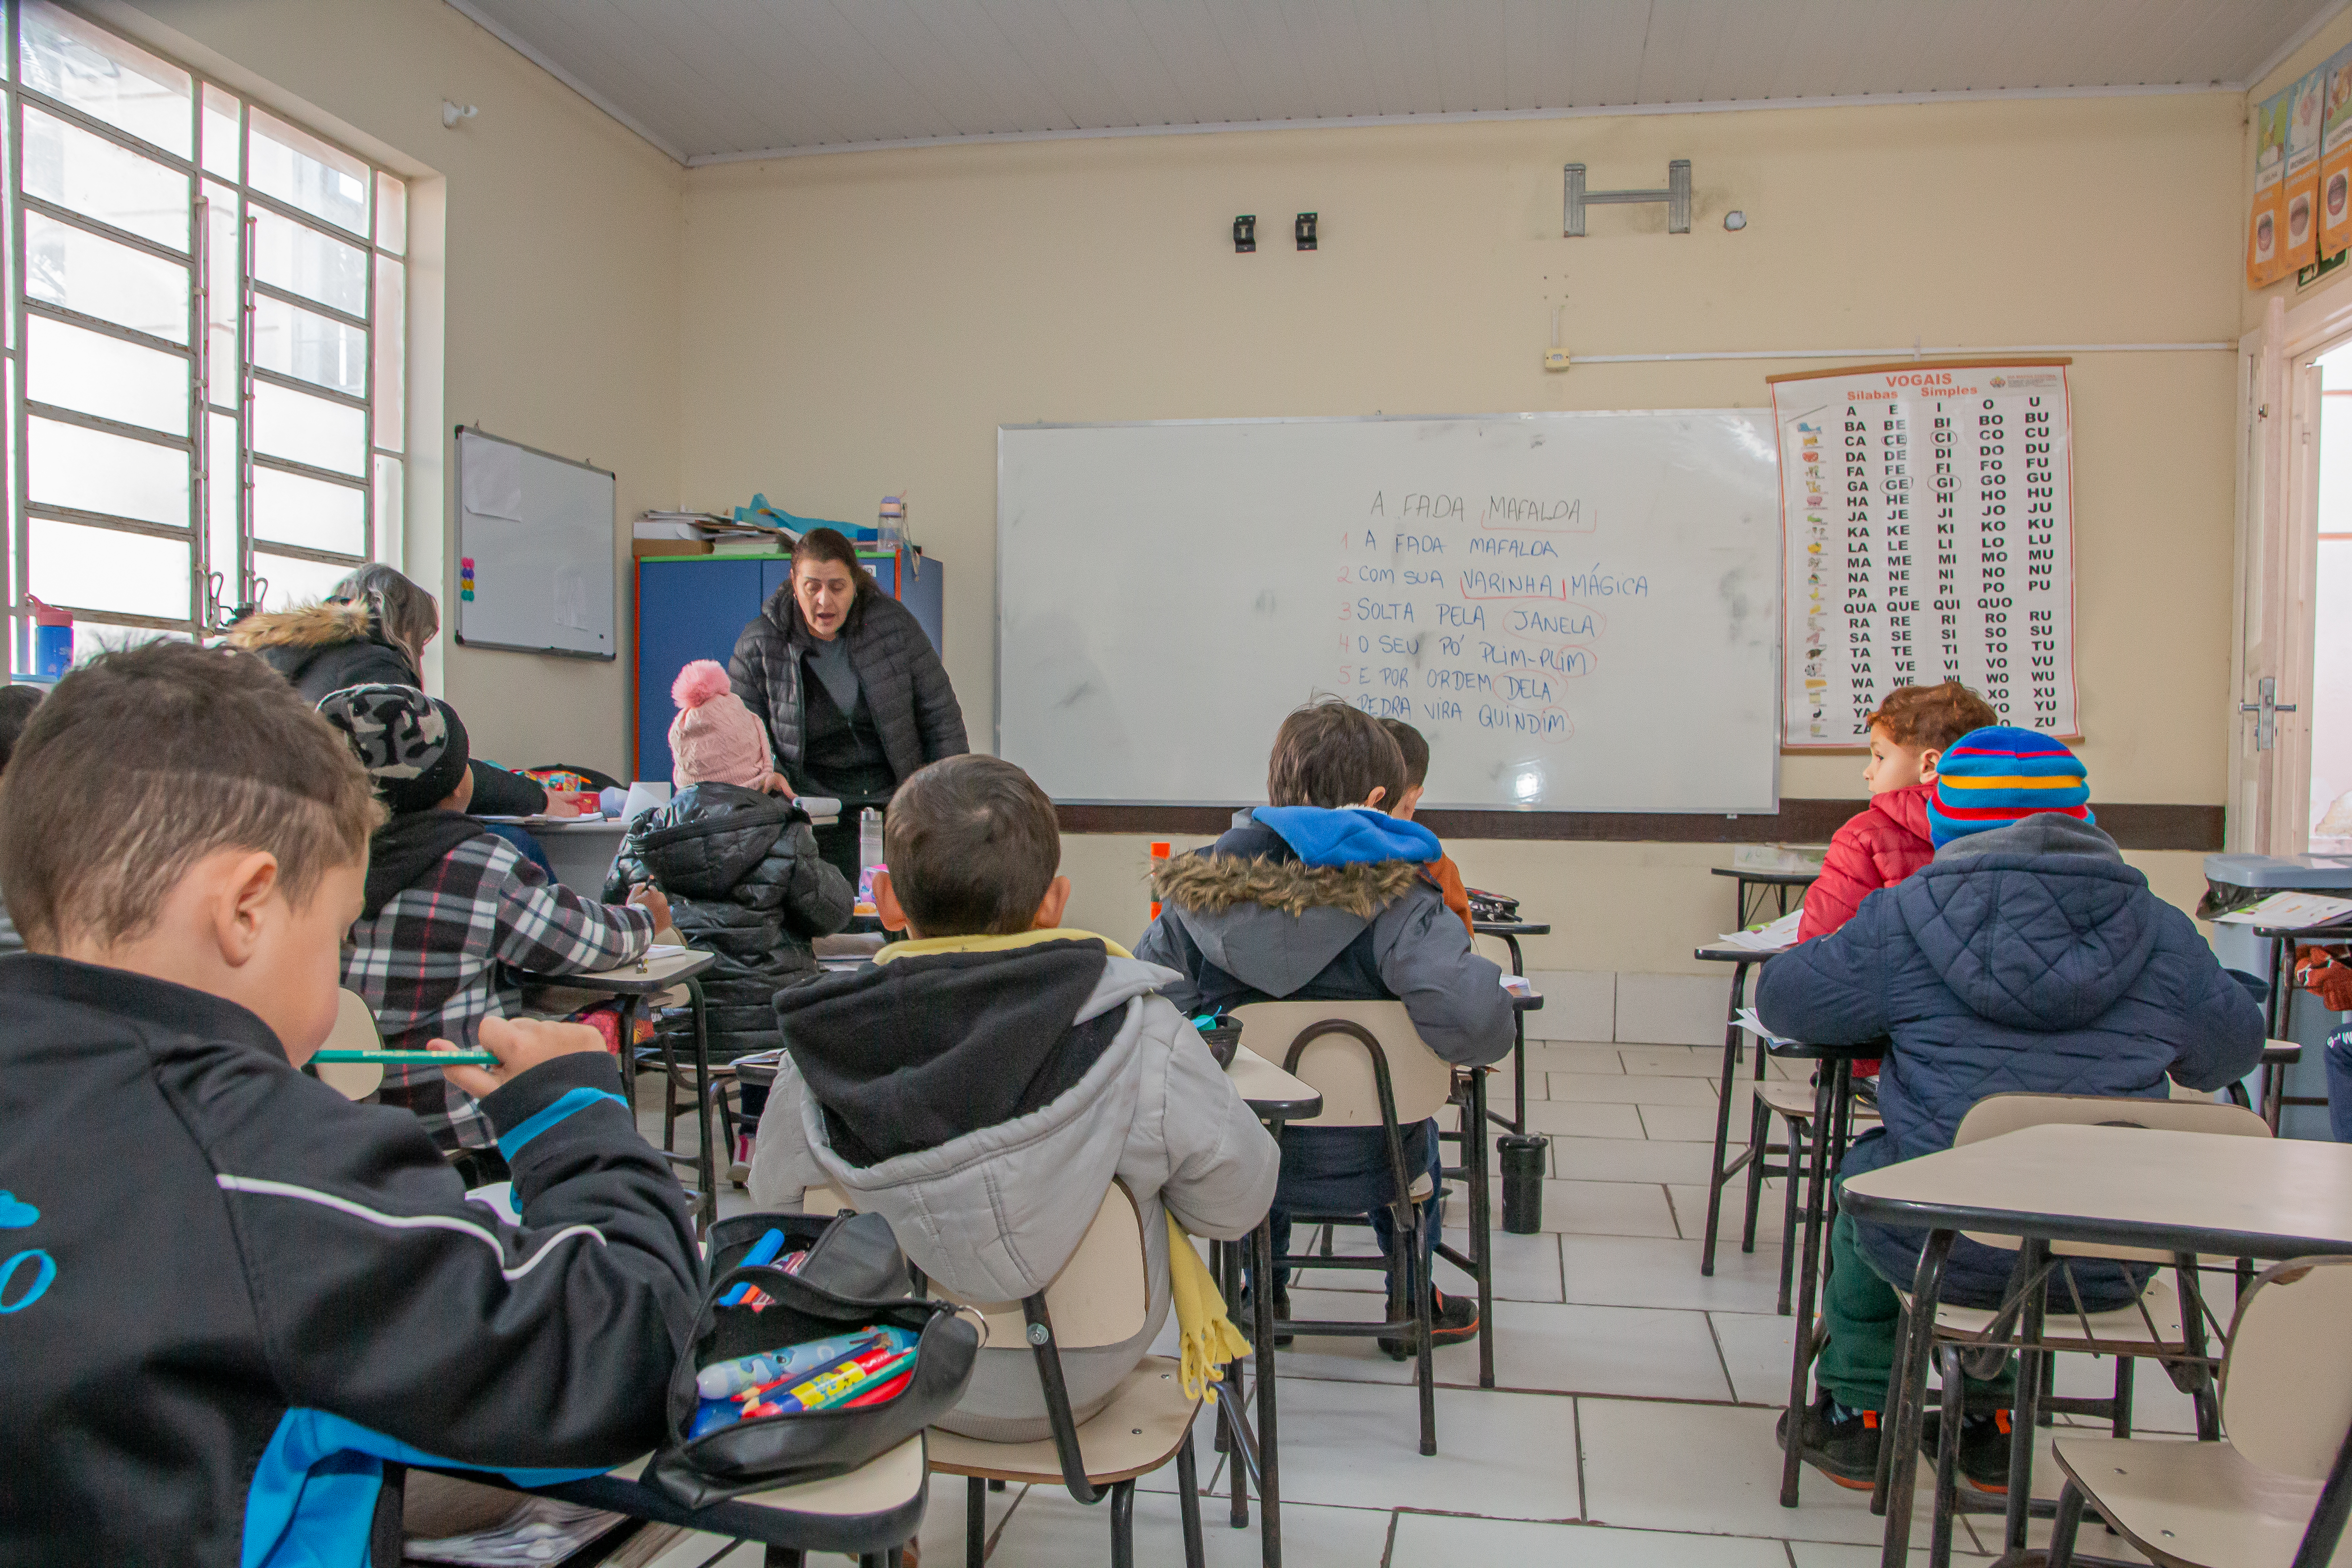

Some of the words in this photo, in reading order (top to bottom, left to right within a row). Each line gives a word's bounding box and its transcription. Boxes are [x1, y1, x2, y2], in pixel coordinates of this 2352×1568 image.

[1886, 373, 1952, 387] VOGAIS
[1921, 386, 1978, 398] Simples
[1847, 407, 1856, 416] A
[1889, 405, 1898, 415] E
[1937, 402, 1941, 412] I
[1983, 400, 1993, 410] O
[2029, 397, 2040, 407] U
[1845, 422, 1866, 431] BA
[1884, 421, 1905, 430] BE
[1934, 418, 1950, 427] BI
[1979, 415, 2003, 425] BO
[2025, 413, 2049, 422] BU
[1845, 436, 1866, 446] CA
[1884, 435, 1906, 446] CE
[1935, 433, 1951, 442] CI
[1980, 430, 2003, 440] CO
[2025, 427, 2049, 437] CU
[1846, 452, 1866, 462] DA
[1884, 450, 1906, 461] DE
[1935, 448, 1951, 458] DI
[1980, 445, 2004, 456] DO
[2026, 443, 2049, 453] DU
[1847, 467, 1864, 477] FA
[1885, 465, 1905, 475] FE
[1936, 463, 1950, 474] FI
[1981, 461, 2002, 471] FO
[2027, 458, 2049, 468] FU
[1847, 482, 1868, 491] GA
[1886, 480, 1908, 490] GE
[1937, 478, 1953, 488] GI
[1981, 475, 2005, 485] GO
[2027, 473, 2051, 482] GU
[1371, 490, 1385, 516] A
[1403, 492, 1463, 522] FADA
[1489, 495, 1580, 523] MAFALDA
[1847, 496, 1868, 507] HA
[1886, 495, 1908, 505] HE
[1937, 492, 1953, 503] HI
[1982, 490, 2006, 500] HO
[2028, 487, 2052, 497] HU
[1848, 512, 1867, 522] JA
[1887, 510, 1908, 520] JE
[1938, 508, 1952, 518] JI
[1982, 505, 2005, 516] JO
[2028, 503, 2051, 513] JU
[1848, 527, 1869, 538] KA
[1887, 525, 1910, 536] KE
[1938, 524, 1954, 534] KI
[1982, 521, 2005, 532] KO
[2028, 519, 2053, 529] KU
[1365, 529, 1376, 550] A
[1395, 533, 1447, 554] FADA
[1470, 538, 1558, 558] MAFALDA
[1848, 543, 1868, 552] LA
[1888, 540, 1908, 550] LE
[1938, 539, 1952, 549] LI
[1982, 537, 2004, 547] LO
[2029, 534, 2051, 544] LU
[1848, 557, 1871, 568] MA
[1887, 556, 1912, 566] ME
[1938, 554, 1956, 564] MI
[1982, 552, 2007, 562] MO
[2029, 549, 2053, 560] MU
[1337, 565, 1352, 584] 2
[1359, 565, 1394, 584] COM
[1403, 570, 1444, 589] SUA
[1848, 572, 1869, 583] NA
[1889, 570, 1910, 581] NE
[1939, 569, 1953, 579] NI
[1983, 567, 2005, 577] NO
[2029, 564, 2051, 574] NU
[1849, 588, 1867, 598] PA
[1889, 586, 1908, 596] PE
[1940, 584, 1952, 594] PI
[1984, 582, 2004, 593] PO
[2029, 580, 2050, 591] PU
[1844, 603, 1877, 614] QUA
[1887, 601, 1920, 611] QUE
[1933, 599, 1960, 610] QUI
[1978, 597, 2012, 609] QUO
[1338, 601, 1352, 621] 3
[1357, 598, 1413, 623] SOLTA
[1437, 604, 1484, 631] PELA
[1513, 610, 1595, 637] JANELA
[1849, 618, 1870, 628] RA
[1890, 616, 1910, 626] RE
[1942, 614, 1955, 624] RI
[1986, 612, 2006, 623] RO
[2030, 610, 2051, 621] RU
[1850, 633, 1870, 643] SA
[1891, 631, 1911, 641] SE
[1942, 629, 1955, 639] SI
[1986, 628, 2006, 638] SO
[2030, 625, 2052, 635] SU
[1338, 634, 1349, 655] 4
[1359, 635, 1369, 653] O
[1379, 635, 1419, 655] SEU
[1440, 635, 1464, 656] PÓ
[1850, 648, 1870, 658] TA
[1891, 646, 1912, 656] TE
[1942, 644, 1957, 654] TI
[1986, 643, 2007, 653] TO
[2032, 641, 2054, 651] TU
[1851, 663, 1871, 673] VA
[1895, 661, 1915, 671] VE
[1943, 659, 1958, 669] VI
[1987, 658, 2007, 668] VO
[2032, 656, 2053, 666] VU
[1338, 665, 1351, 684] 5
[1360, 667, 1369, 684] E
[1379, 667, 1408, 687] POR
[1427, 668, 1491, 691] ORDEM
[1504, 675, 1551, 702] DELA
[1851, 678, 1873, 688] WA
[1893, 676, 1914, 687] WE
[1986, 673, 2009, 683] WO
[2032, 671, 2054, 681] WU
[1853, 693, 1872, 704] XA
[1988, 689, 2009, 699] XO
[2034, 687, 2054, 697] XU
[1357, 694, 1411, 720] PEDRA
[2034, 701, 2056, 712] YU
[2035, 717, 2055, 727] ZU
